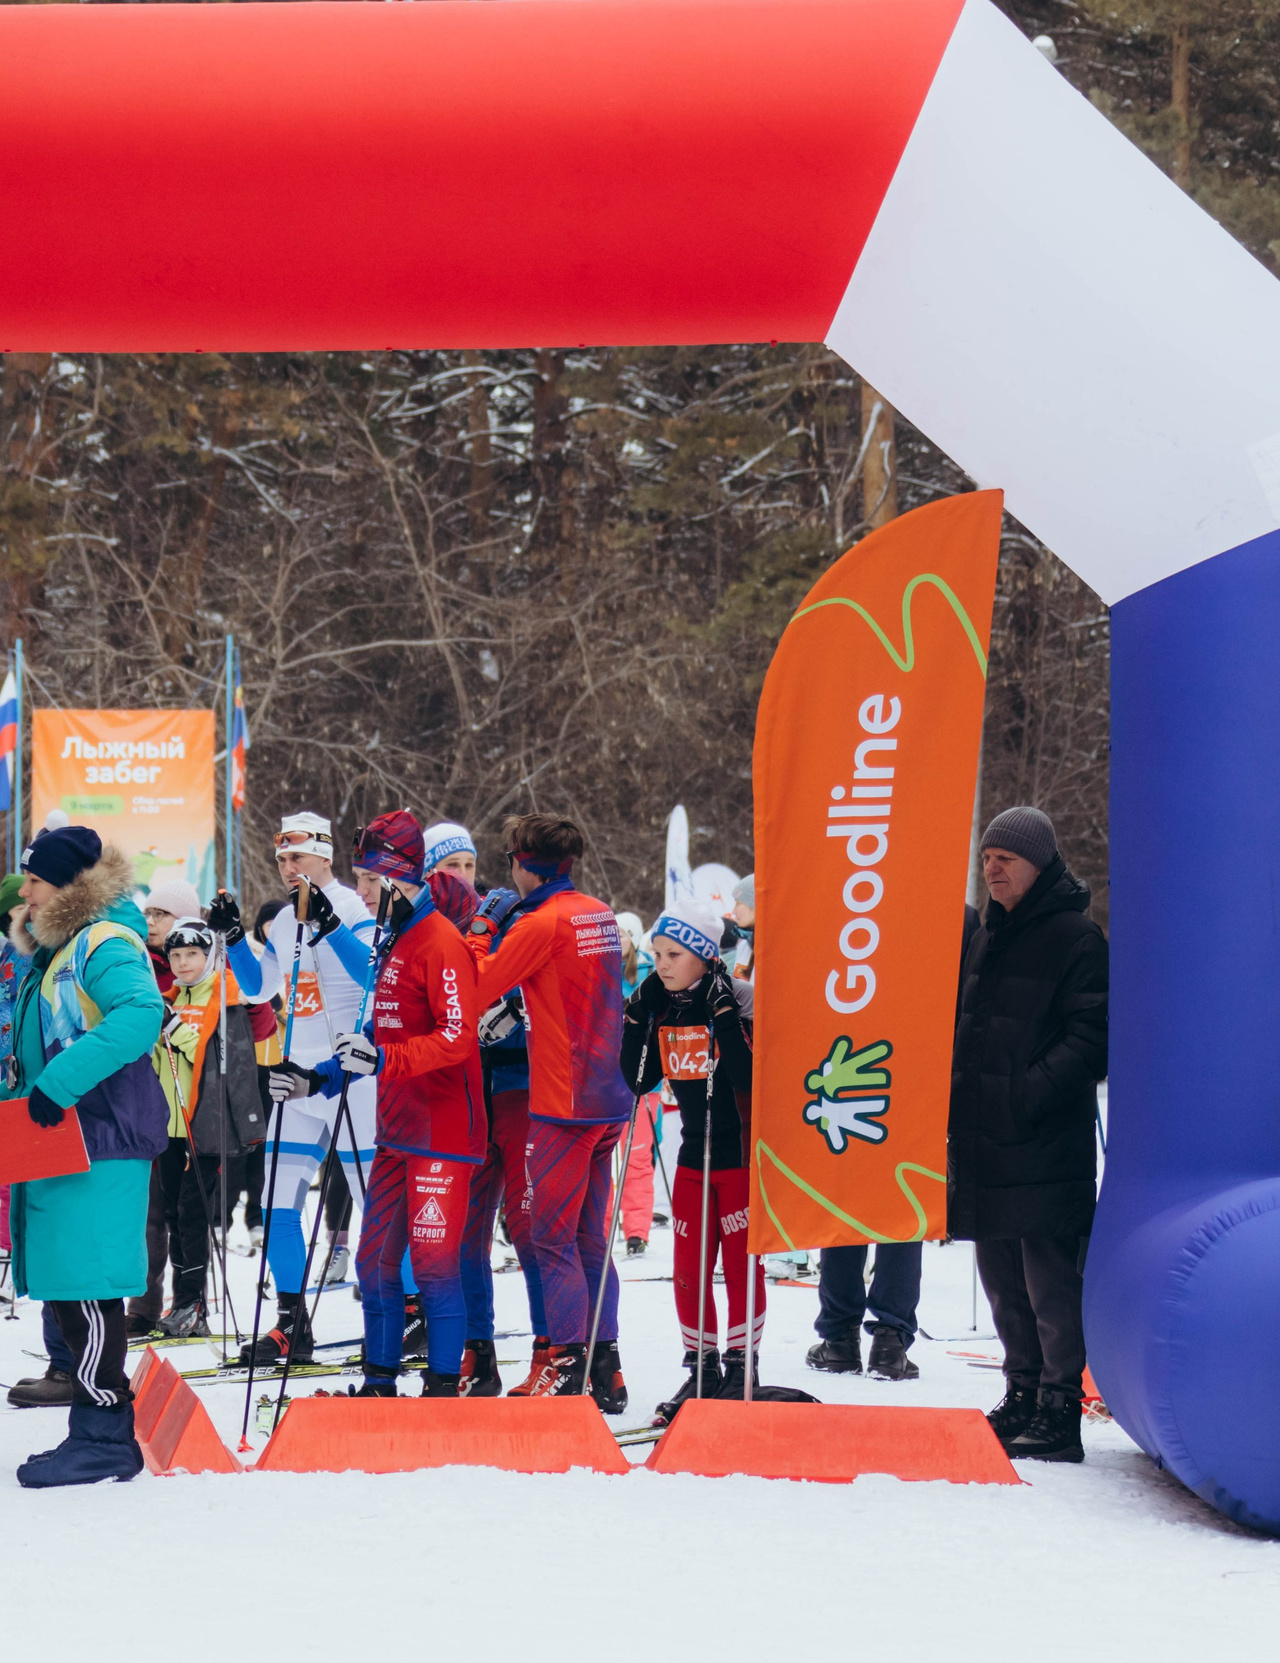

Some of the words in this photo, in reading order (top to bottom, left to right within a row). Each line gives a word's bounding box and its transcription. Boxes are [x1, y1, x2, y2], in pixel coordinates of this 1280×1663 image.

[61, 736, 185, 759] Лыжный
[85, 760, 162, 784] забег
[80, 802, 114, 812] марта
[825, 693, 903, 1015] Goodline
[664, 919, 716, 960] 2026
[441, 968, 463, 1043] КУЗБАСС
[668, 1051, 710, 1074] 042
[413, 1226, 447, 1239] БЕРЛОГА
